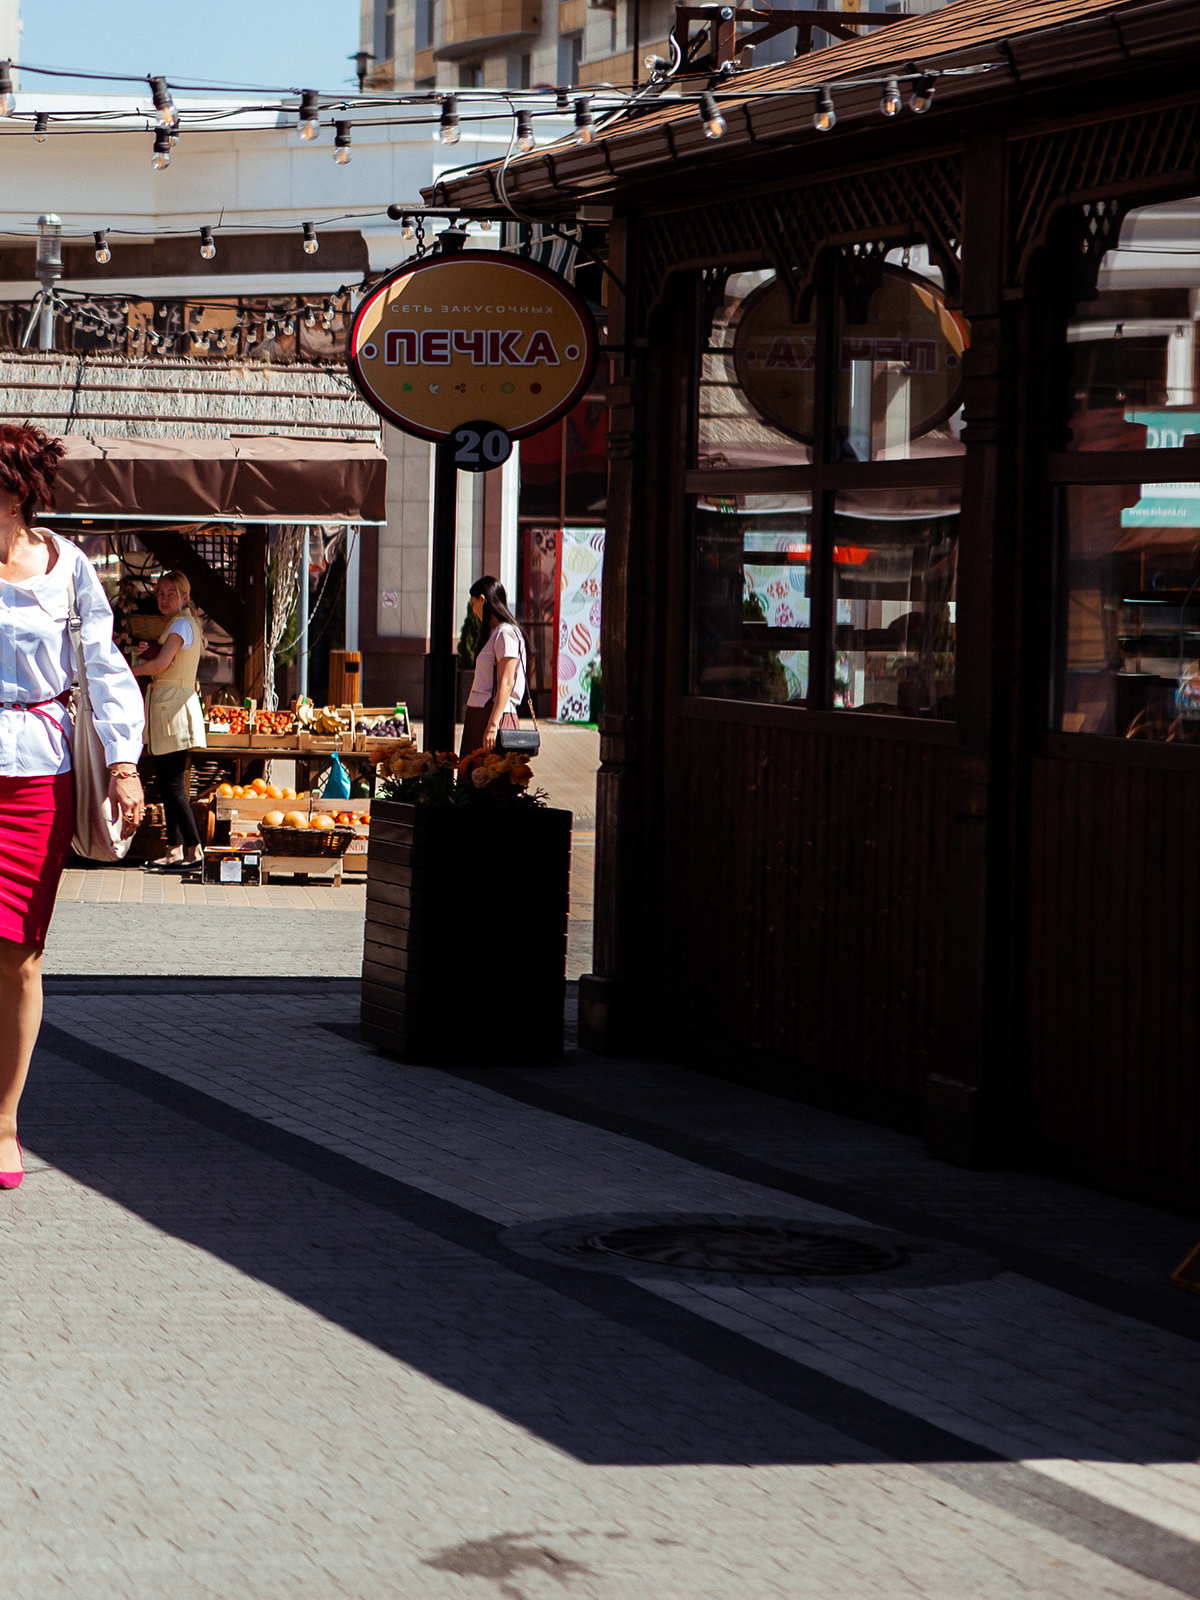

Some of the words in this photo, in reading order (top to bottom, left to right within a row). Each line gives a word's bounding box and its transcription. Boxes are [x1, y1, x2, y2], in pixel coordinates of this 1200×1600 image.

[391, 304, 433, 313] СЕТЬ
[441, 305, 554, 314] ЗАКУСОЧНЫХ
[384, 329, 561, 366] ПЕЧКА
[453, 429, 511, 464] 20
